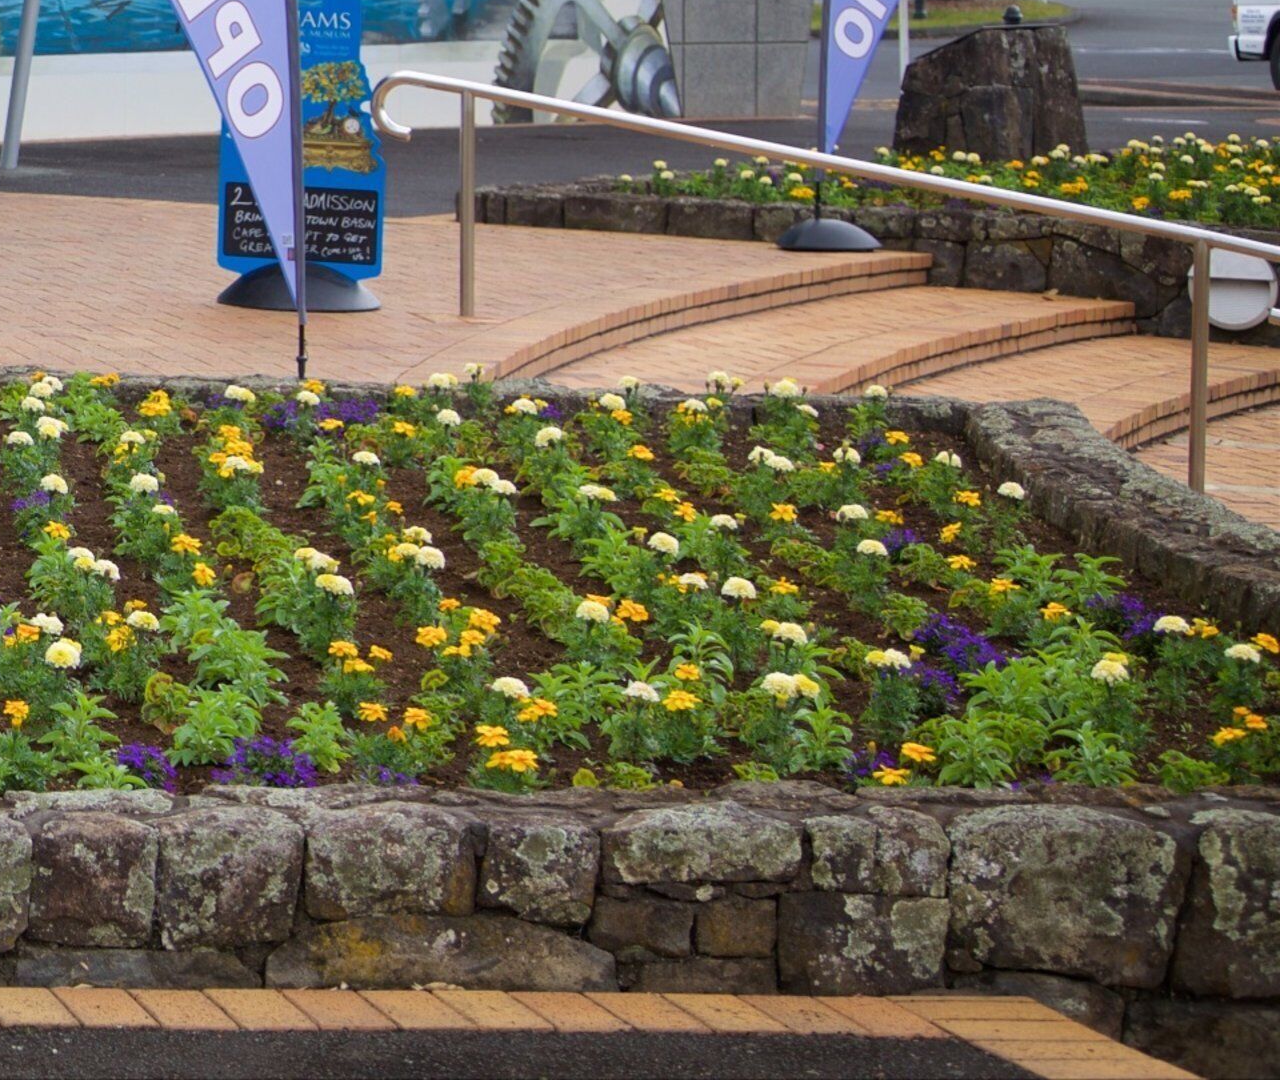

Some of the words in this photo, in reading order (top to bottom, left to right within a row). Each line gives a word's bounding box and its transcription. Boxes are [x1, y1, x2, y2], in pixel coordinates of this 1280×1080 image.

[297, 11, 352, 30] AMS
[303, 192, 376, 213] ADMISSION
[234, 209, 264, 224] BRIN
[306, 215, 338, 226] TOWN
[341, 217, 376, 230] BASIN
[232, 227, 264, 240] CAFE
[344, 232, 368, 244] GET
[240, 239, 272, 254] GREA
